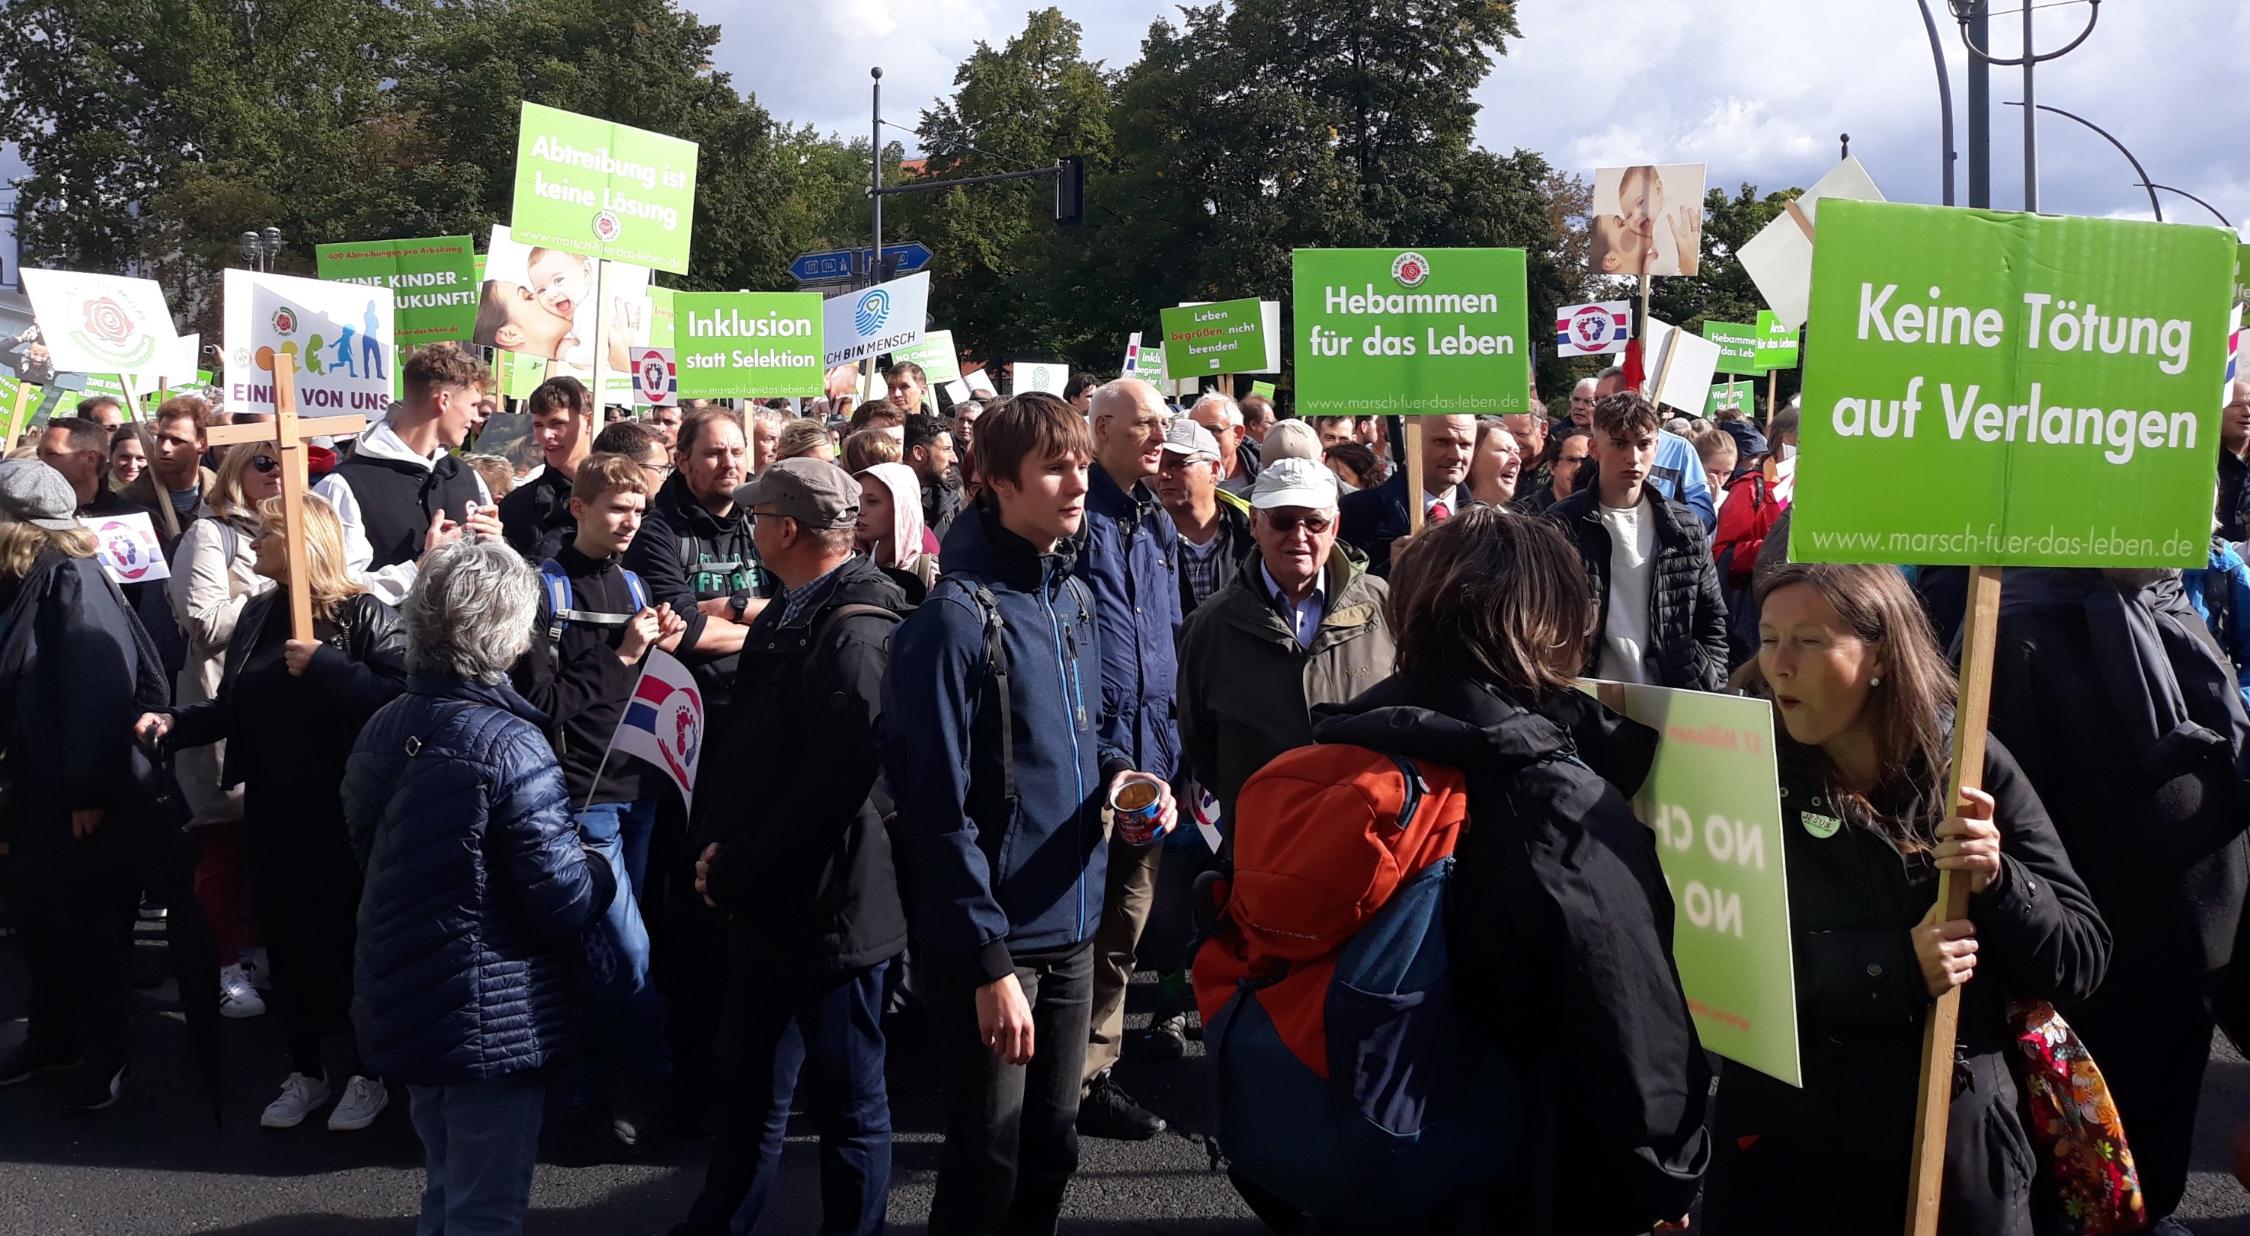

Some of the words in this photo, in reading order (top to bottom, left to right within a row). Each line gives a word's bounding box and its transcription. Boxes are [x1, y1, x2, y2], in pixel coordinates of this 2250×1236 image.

[530, 134, 657, 190] Abtreibung
[662, 163, 687, 190] ist
[534, 170, 597, 207] keine
[602, 186, 678, 232] Lösung
[346, 248, 401, 260] Abtreibungen
[403, 248, 418, 256] pro
[420, 246, 463, 255] Arbeitstag
[388, 271, 458, 289] KINDER
[394, 291, 475, 310] UKUNFT!
[1325, 283, 1498, 315] Hebammen
[688, 308, 812, 337] Inklusion
[1194, 310, 1228, 322] Leben
[1228, 322, 1256, 335] nicht
[1309, 325, 1353, 356] für
[1362, 325, 1416, 356] das
[1427, 324, 1514, 356] Leben
[1711, 332, 1756, 346] Hebamme
[1857, 282, 2004, 348] Keine
[2023, 292, 2193, 376] Tötung
[843, 344, 865, 361] BIN
[866, 331, 916, 353] MENSCH
[1188, 340, 1238, 355] beenden!
[1720, 346, 1737, 356] das
[1739, 347, 1755, 358] Leb
[686, 352, 727, 369] statt
[732, 348, 816, 369] Selektion
[302, 387, 344, 408] VON
[350, 392, 389, 411] UNS
[1831, 376, 1924, 439] auf
[1939, 382, 2198, 466] Verlangen
[1811, 523, 2193, 559] www.marsch-fuer-das-leben.de
